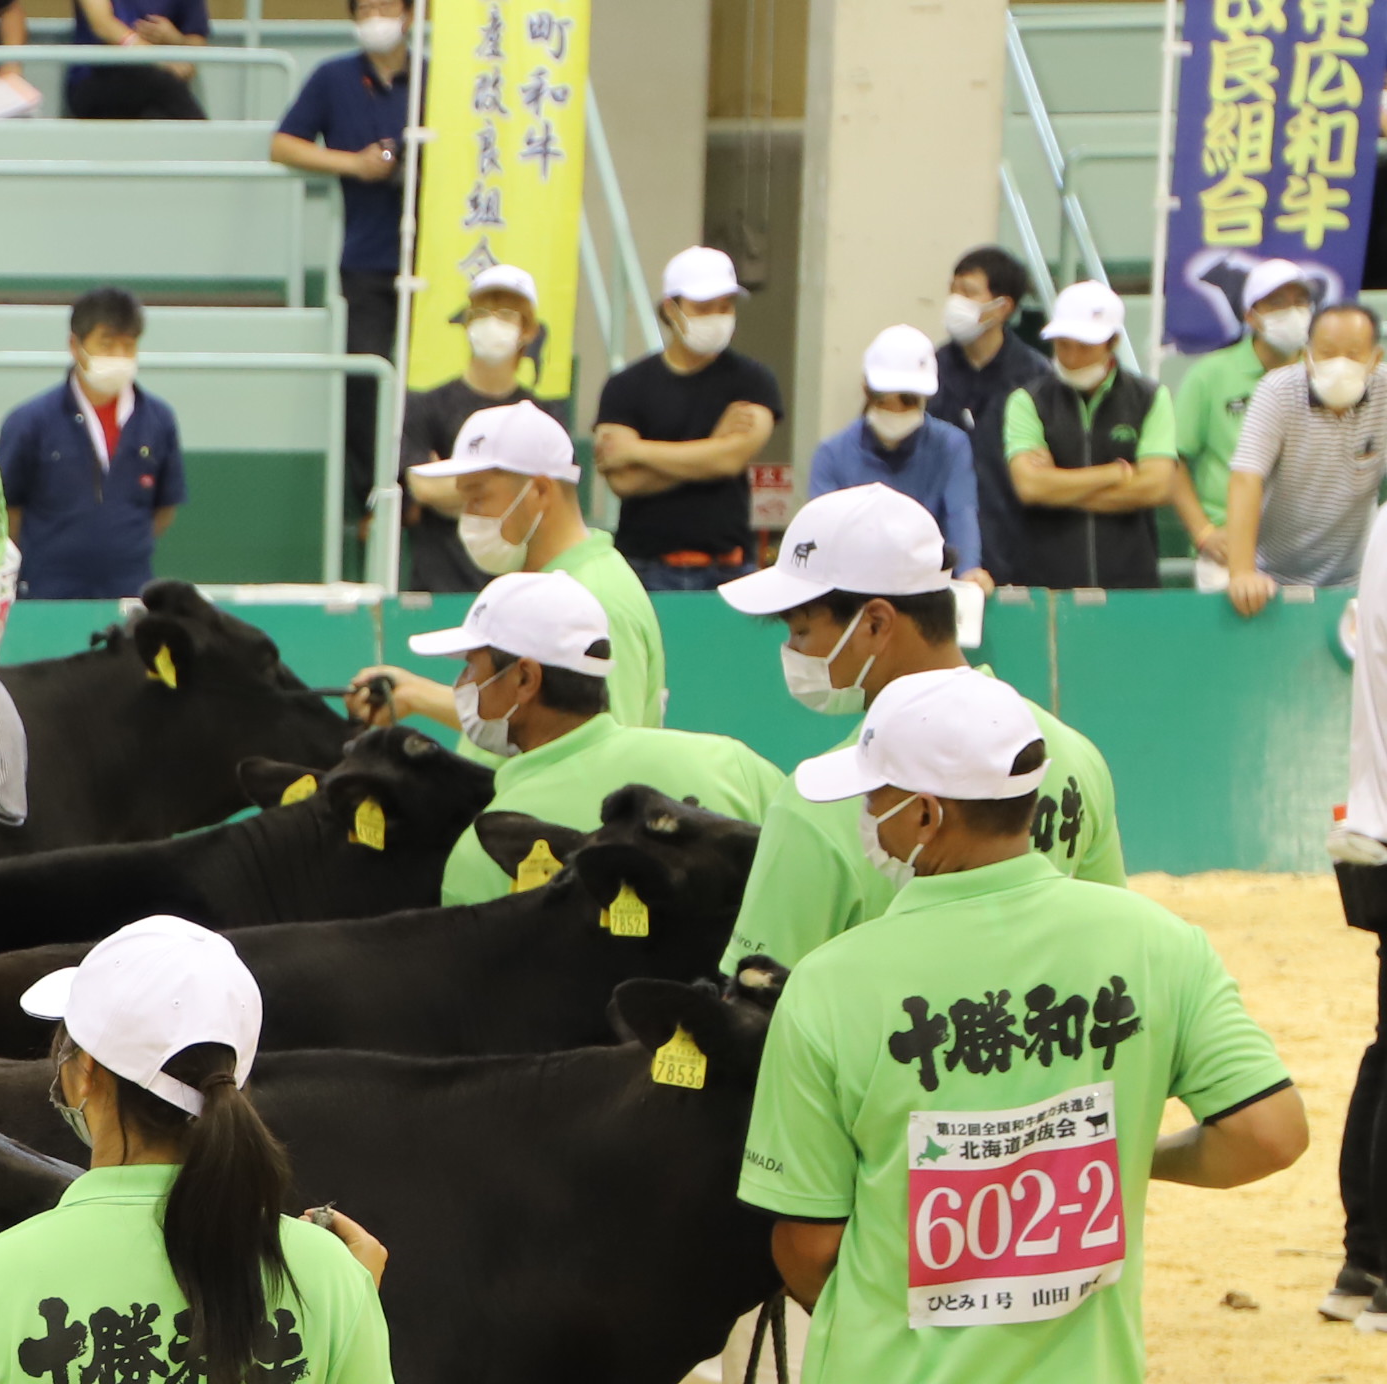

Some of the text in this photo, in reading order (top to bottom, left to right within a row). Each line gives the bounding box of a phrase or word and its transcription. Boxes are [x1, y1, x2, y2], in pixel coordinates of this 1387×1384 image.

[519, 10, 573, 181] 町和牛
[888, 975, 1144, 1092] 十勝和牛
[960, 1118, 1076, 1160] 北海道選抜会
[915, 1160, 1119, 1270] 602-2
[928, 1286, 1070, 1312] ひとみ1号 山田
